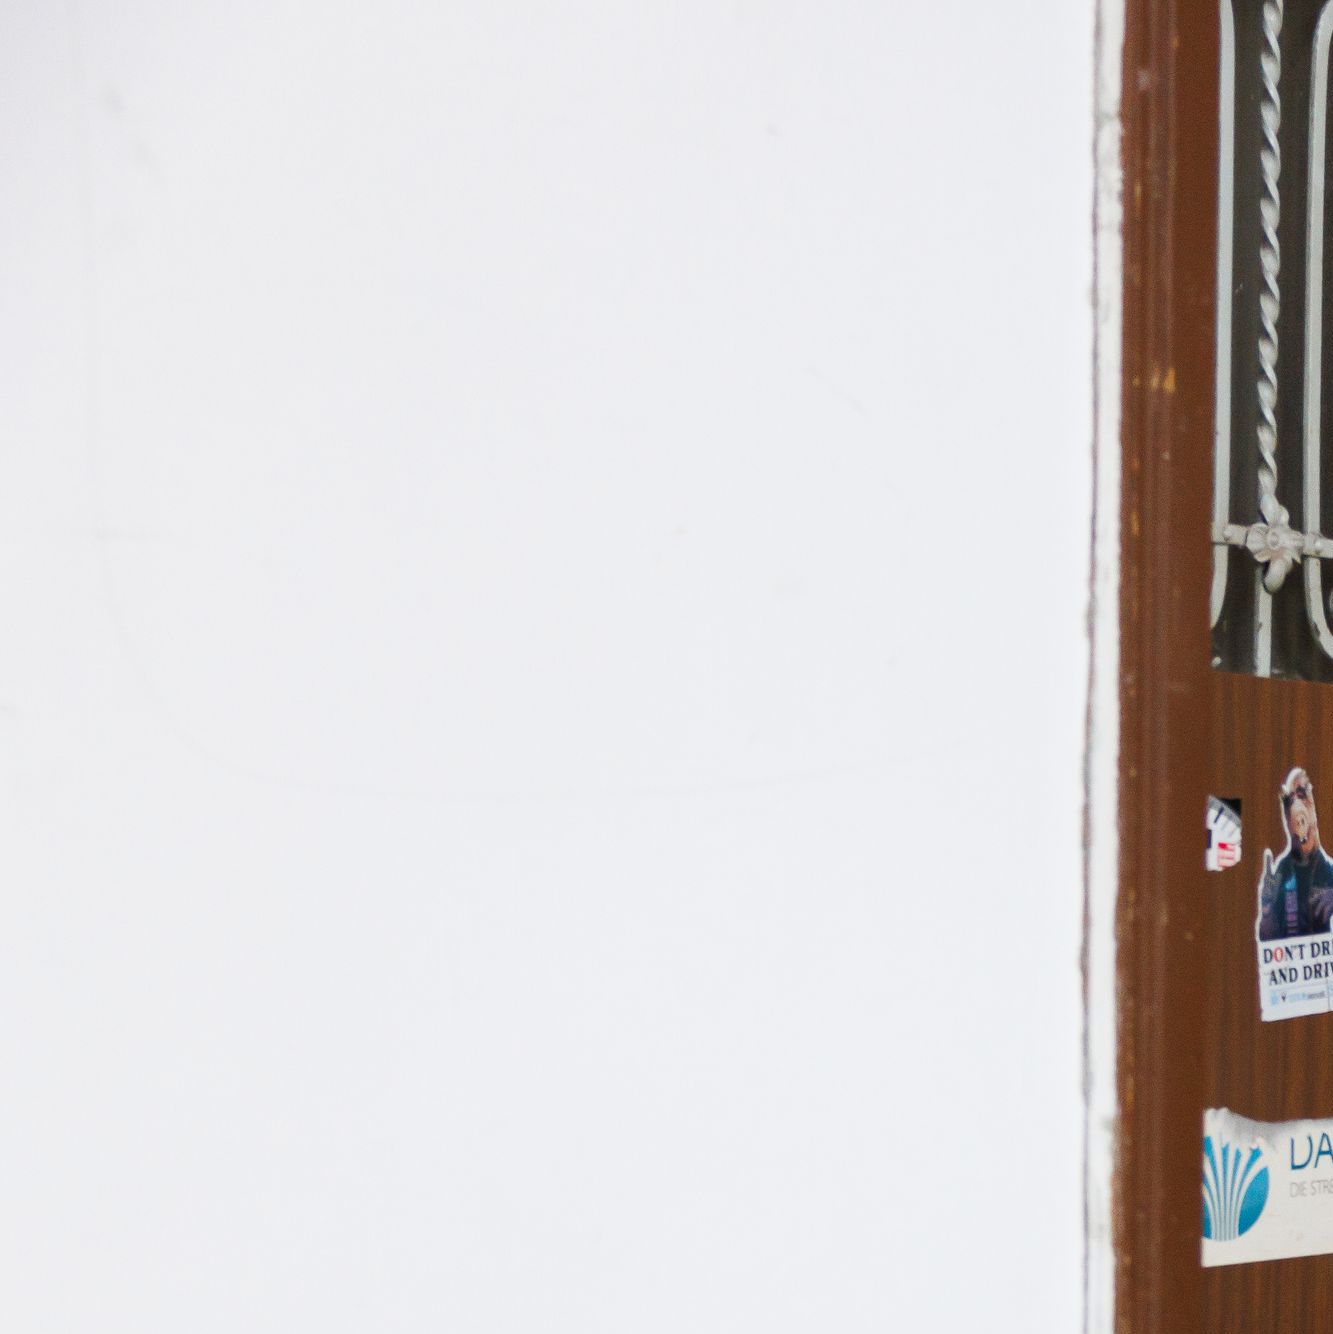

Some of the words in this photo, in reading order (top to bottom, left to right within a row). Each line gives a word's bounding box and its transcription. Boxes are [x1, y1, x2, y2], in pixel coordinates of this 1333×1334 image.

[1263, 944, 1306, 964] DON'T
[1269, 967, 1298, 986] AND
[1289, 1181, 1309, 1197] DIE
